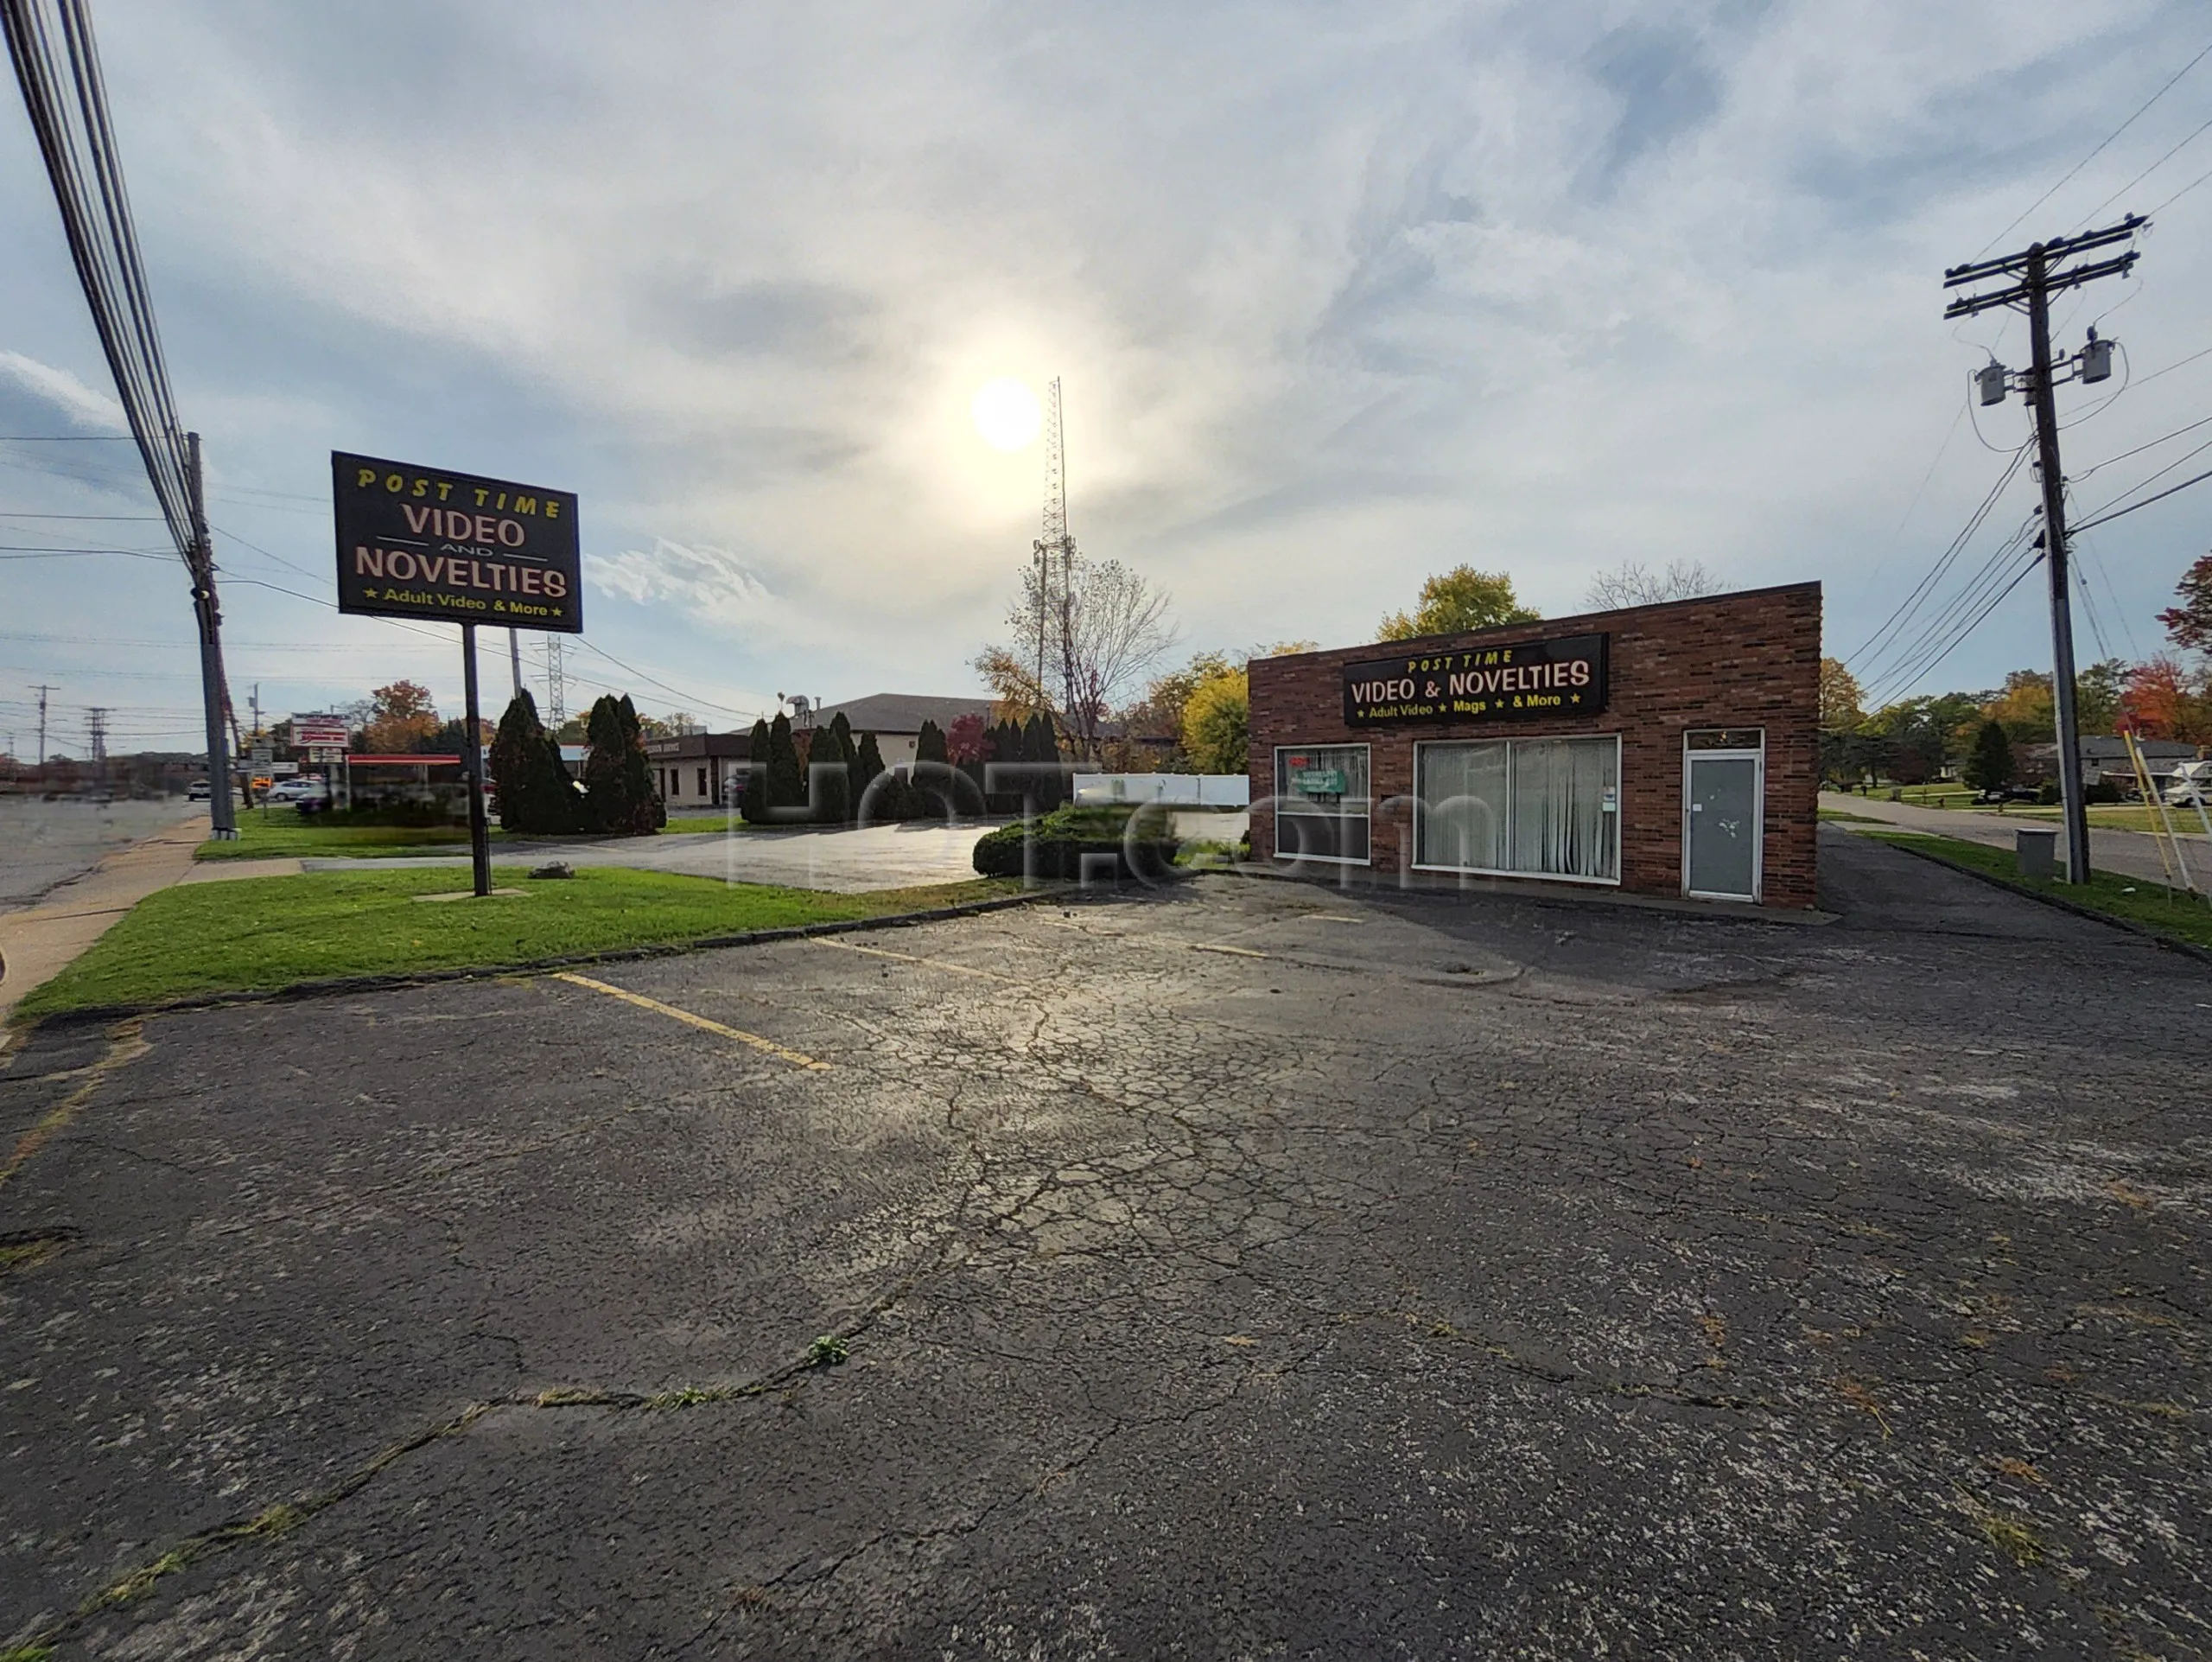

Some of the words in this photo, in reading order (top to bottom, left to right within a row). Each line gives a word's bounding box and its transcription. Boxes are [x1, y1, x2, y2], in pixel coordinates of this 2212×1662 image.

[358, 468, 453, 501] POST
[474, 488, 560, 519] TIME
[400, 504, 524, 546] VIDEO
[440, 544, 494, 557] AND
[356, 546, 567, 597] NOVELTIES
[383, 589, 433, 605] Adult
[437, 594, 486, 610] Video
[493, 600, 505, 612] &
[510, 602, 548, 616] More
[1408, 655, 1452, 673] POST
[1463, 650, 1513, 668] TIME
[1351, 678, 1414, 703] VIDEO
[1425, 680, 1441, 697] &
[1448, 660, 1590, 696] NOVELTIES
[1369, 704, 1398, 719] Adult
[1400, 704, 1433, 716] Video
[1453, 699, 1486, 715] Mags
[1513, 695, 1522, 708] &
[1527, 695, 1560, 707] More
